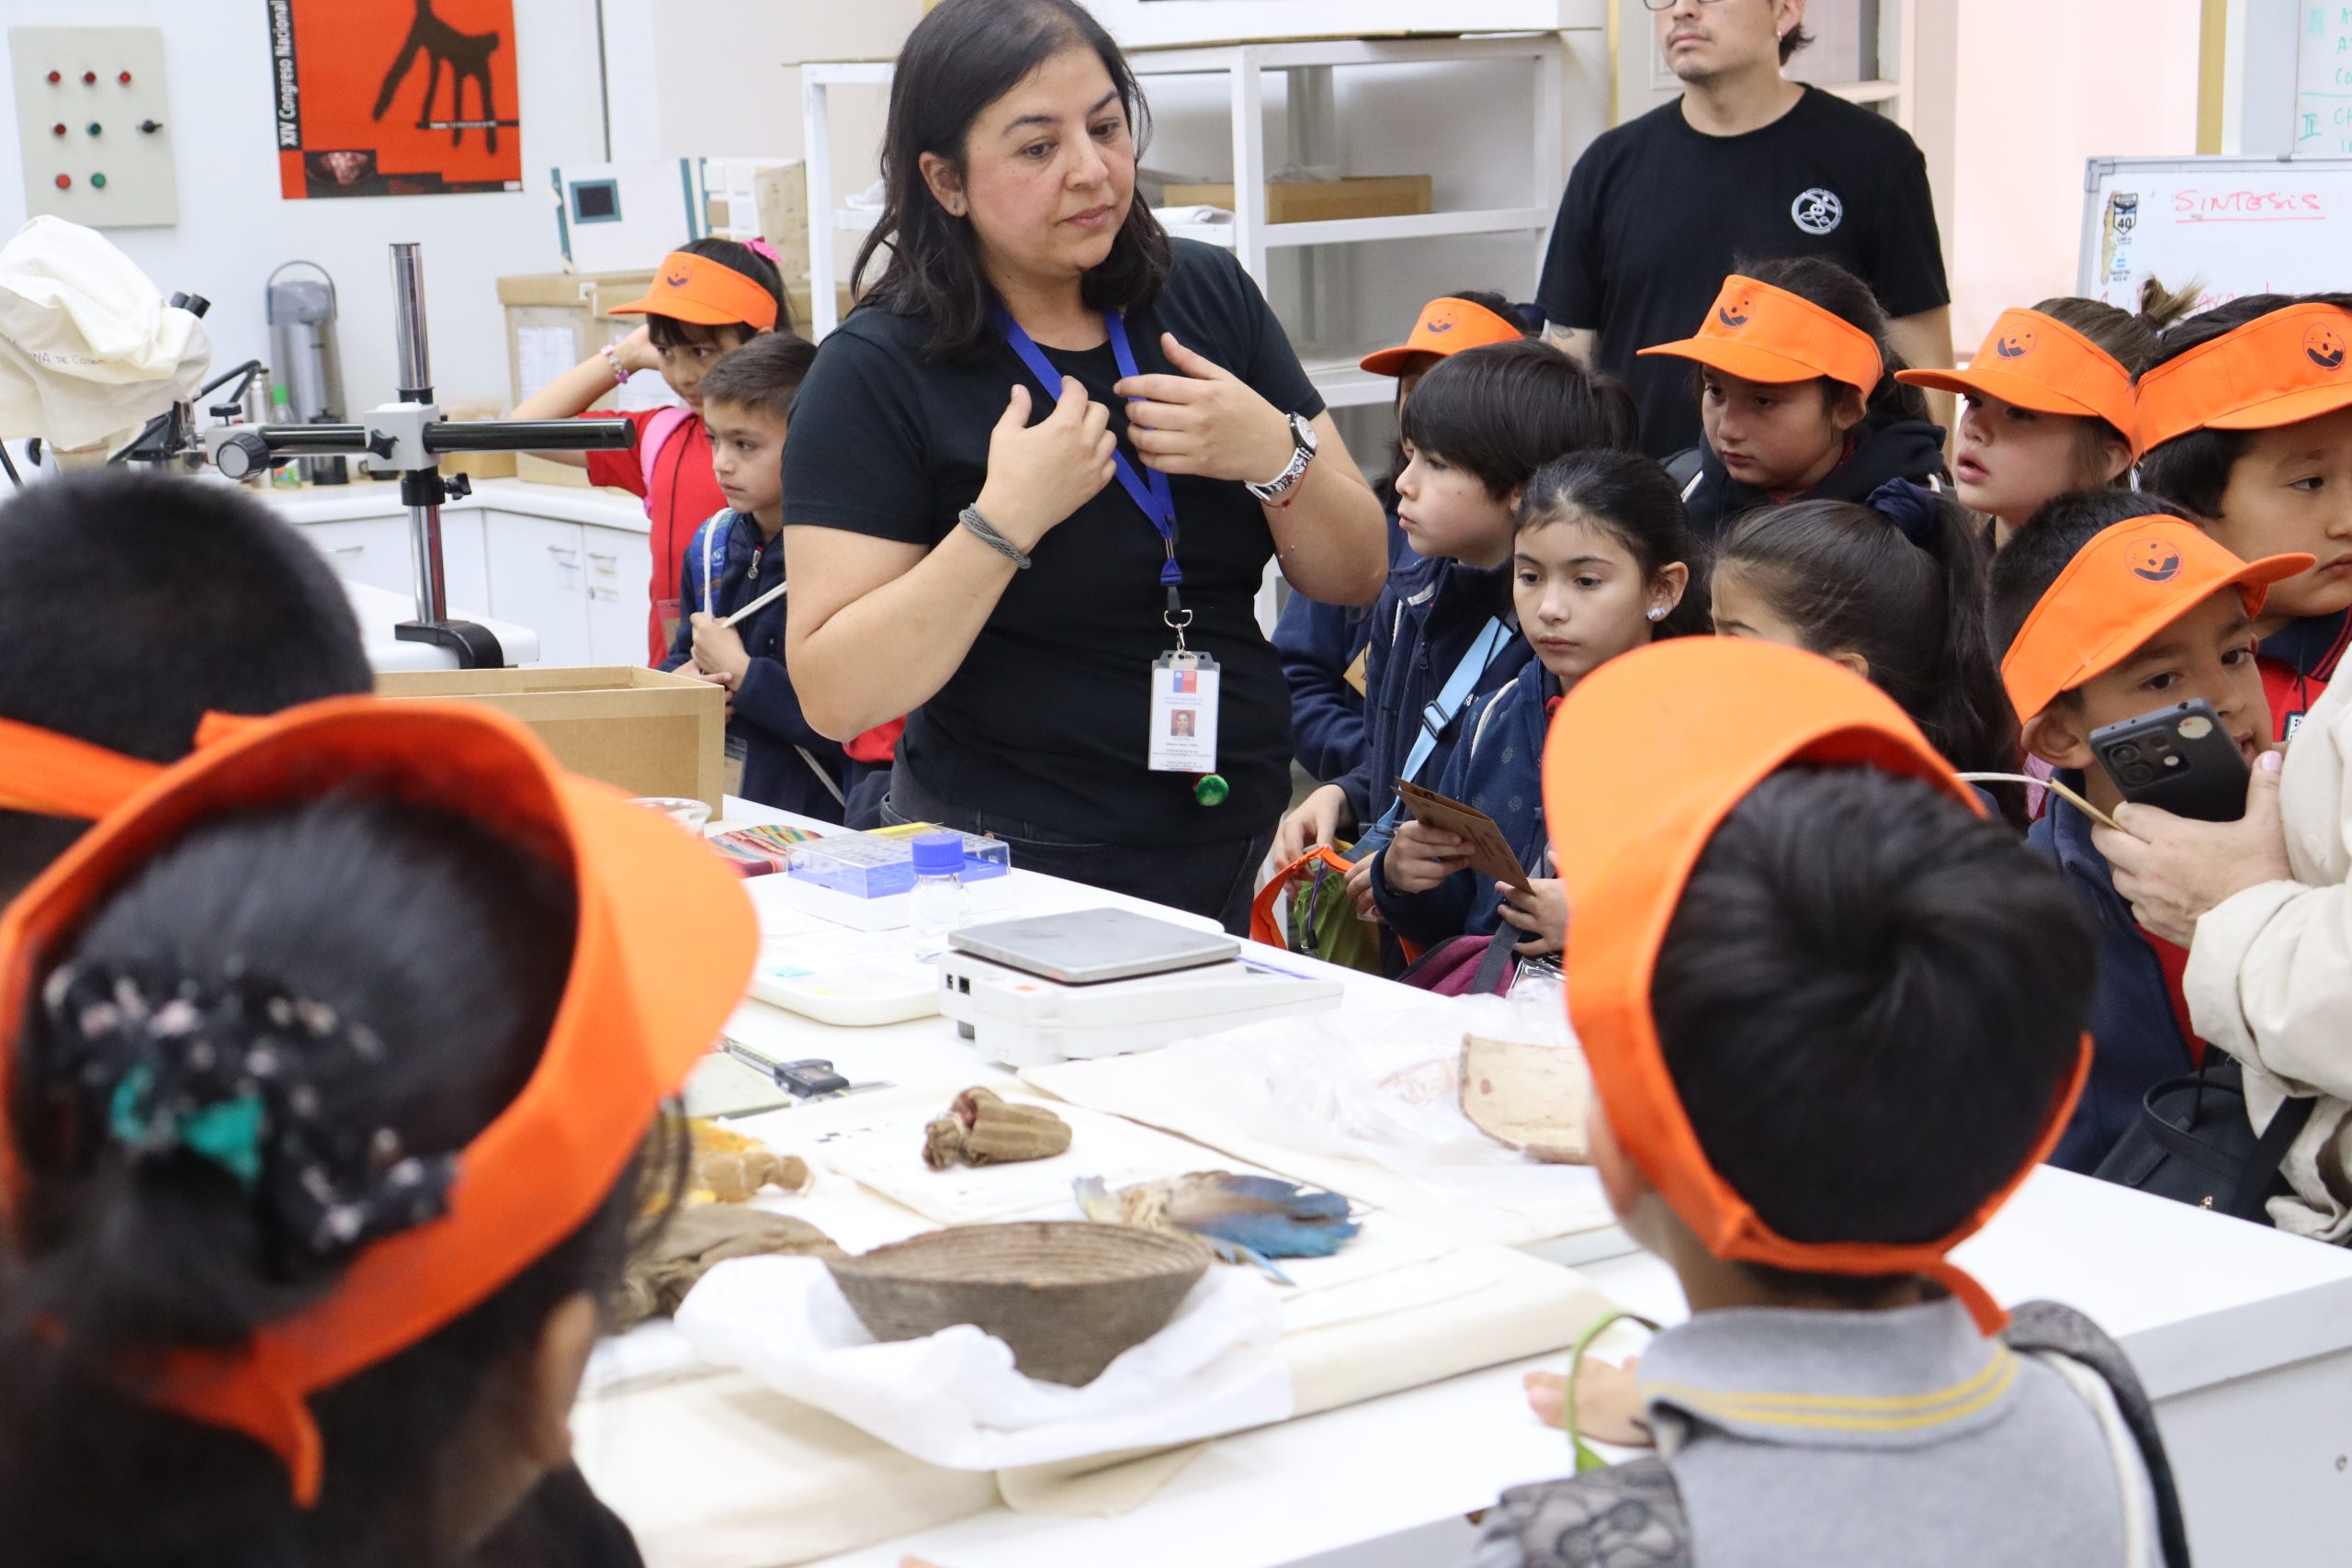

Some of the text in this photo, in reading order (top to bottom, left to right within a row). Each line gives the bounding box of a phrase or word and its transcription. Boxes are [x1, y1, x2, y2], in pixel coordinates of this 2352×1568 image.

[269, 0, 300, 147] XIV Congreso Nacional
[2117, 217, 2132, 229] 40
